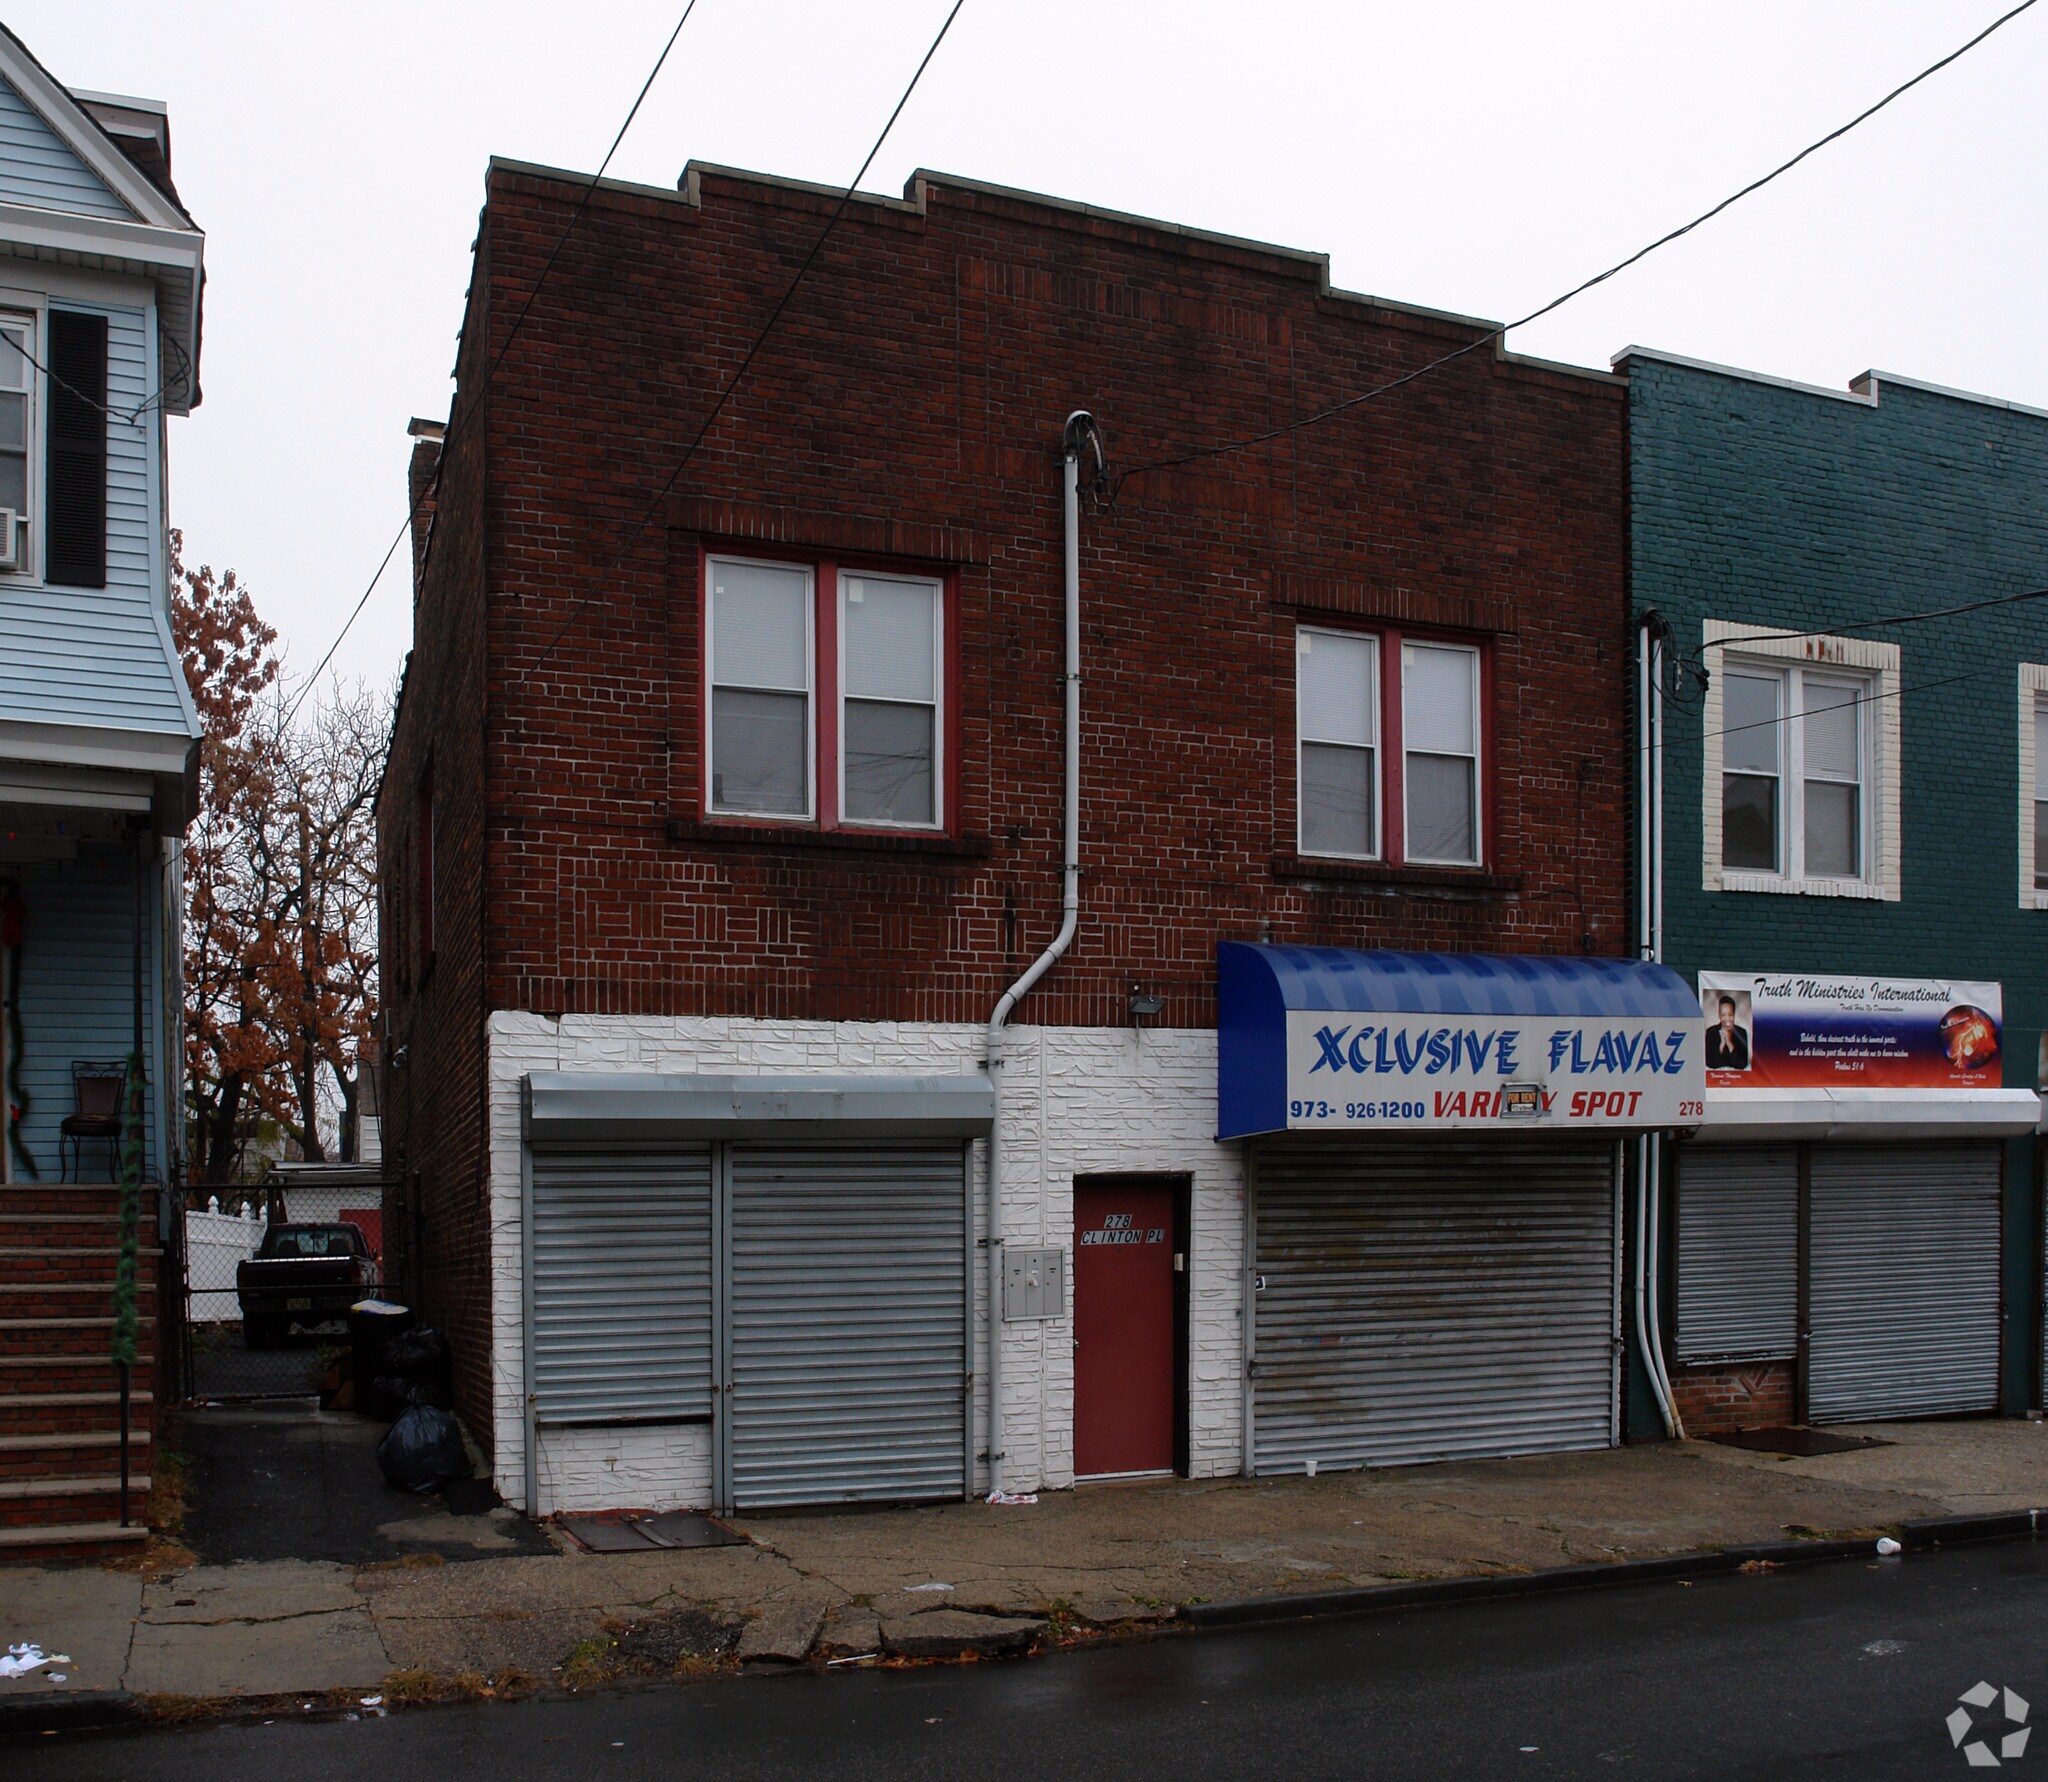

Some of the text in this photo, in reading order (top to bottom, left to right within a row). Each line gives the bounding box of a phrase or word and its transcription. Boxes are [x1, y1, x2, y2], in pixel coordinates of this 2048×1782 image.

[1754, 977, 1952, 1003] Truth Ministries International
[1308, 1024, 1688, 1076] XCLUSIVE FLAVAZ
[1433, 1090, 1643, 1118] VARIY SPOT
[1507, 1092, 1537, 1104] FOR RENT
[1679, 1101, 1704, 1117] 278
[1105, 1215, 1132, 1228] 278
[1082, 1229, 1163, 1245] CLINTON PL
